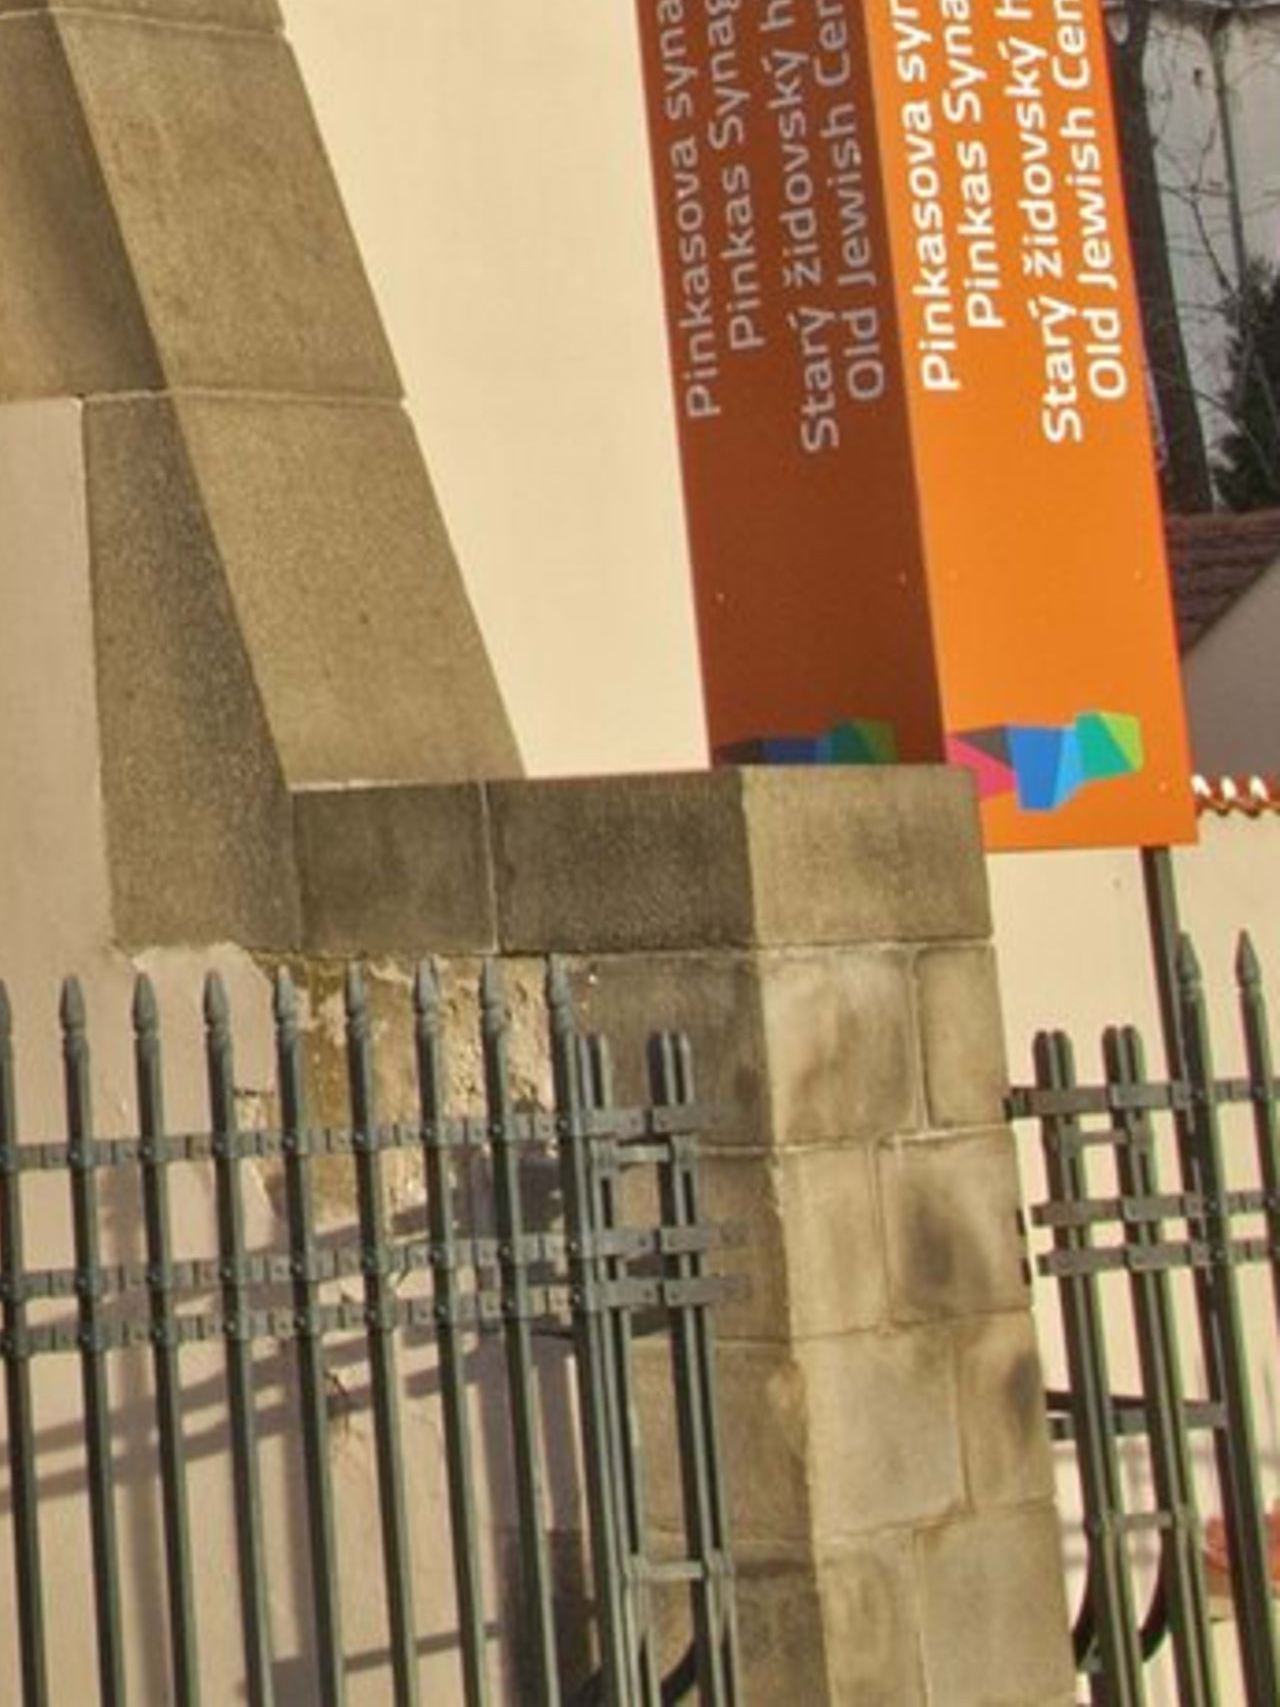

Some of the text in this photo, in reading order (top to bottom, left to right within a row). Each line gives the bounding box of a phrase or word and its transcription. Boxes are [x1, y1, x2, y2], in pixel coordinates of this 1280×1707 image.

[761, 49, 821, 287] židovský
[821, 103, 876, 286] Jewish
[902, 100, 960, 391] Pinkasova
[957, 140, 1005, 328] Pinkas
[997, 36, 1062, 278] židovský
[1058, 107, 1118, 290] Jewish
[669, 136, 721, 418] Pinkasova
[720, 164, 764, 350] Pinkas
[787, 305, 839, 451] Starý
[842, 307, 884, 400] Old
[1028, 295, 1082, 444] Starý
[1080, 307, 1128, 399] Old
